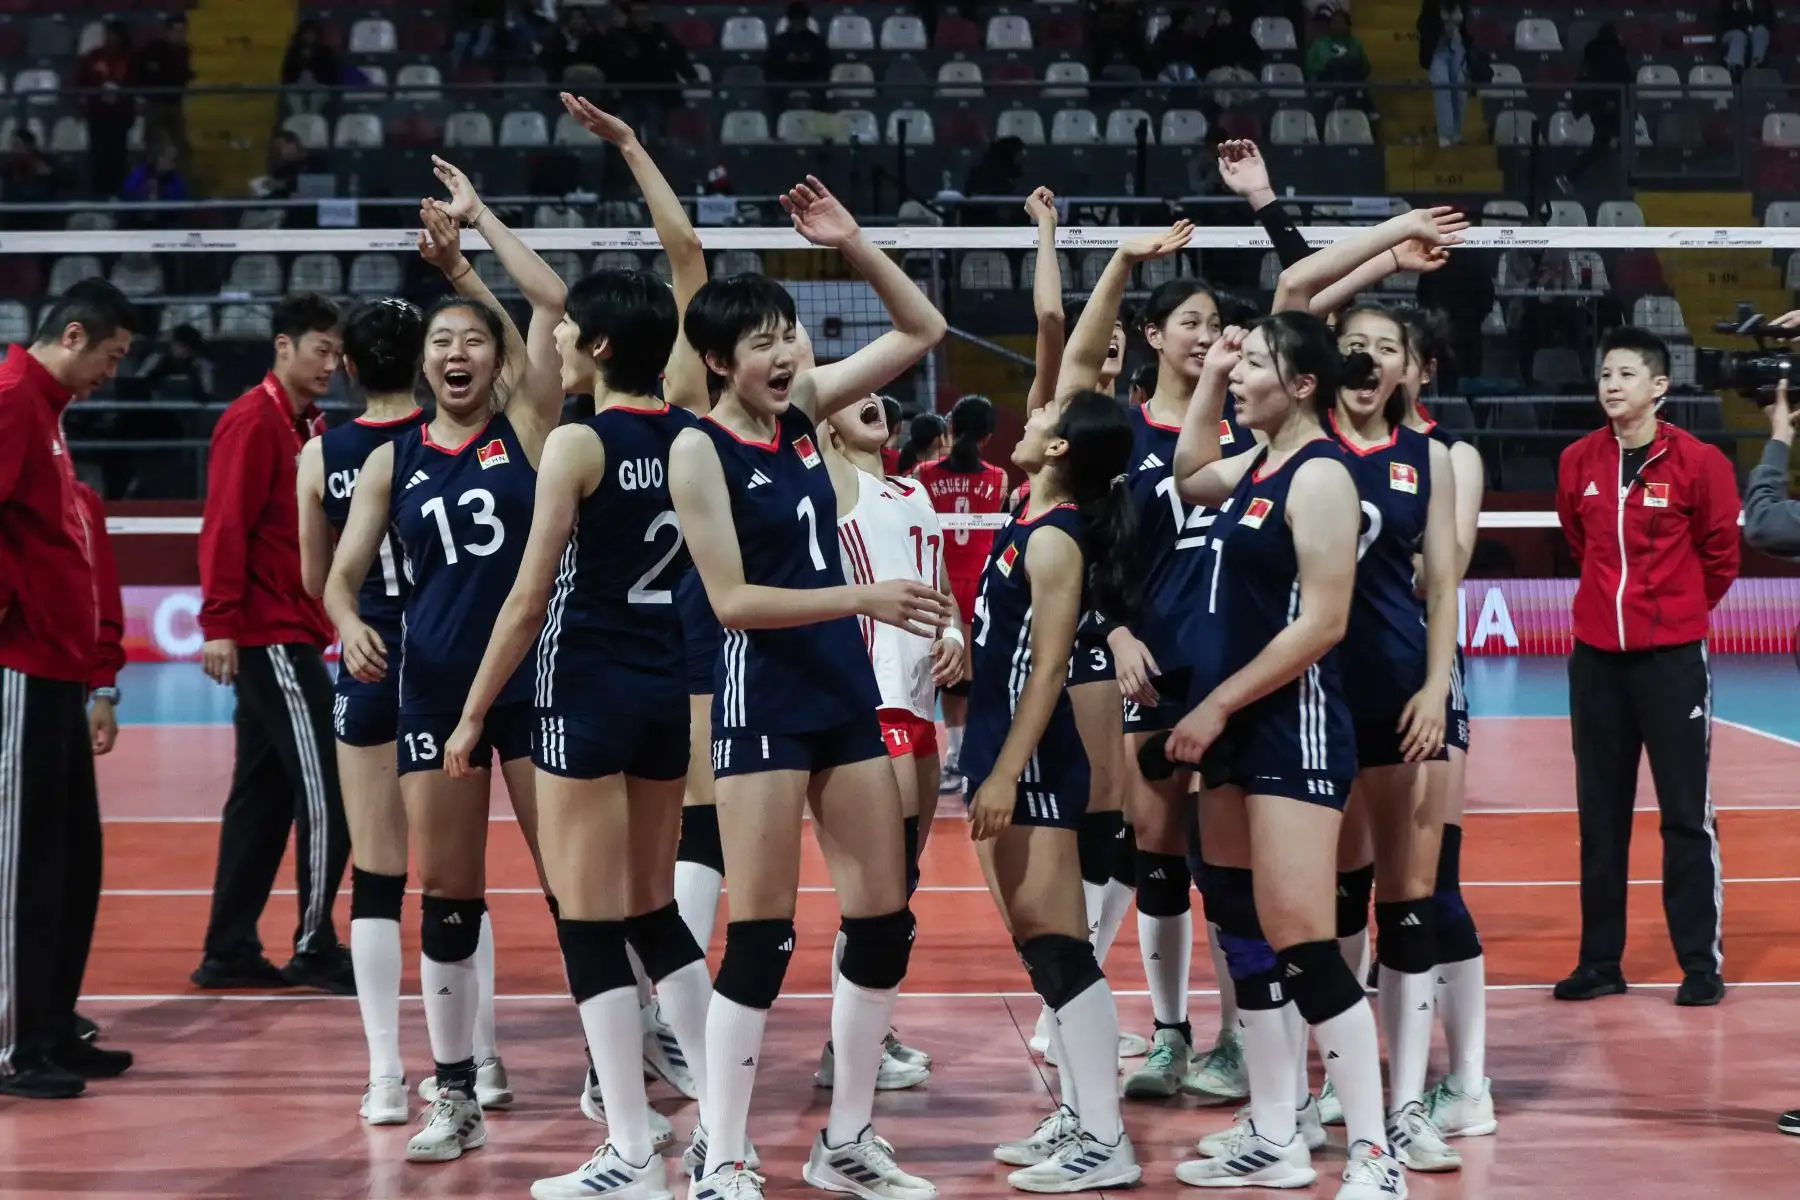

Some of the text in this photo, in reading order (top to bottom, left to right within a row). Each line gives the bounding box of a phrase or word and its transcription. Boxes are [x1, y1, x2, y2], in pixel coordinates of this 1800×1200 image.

[618, 457, 663, 491] GUO
[931, 477, 970, 498] HSUEH
[420, 488, 505, 566] 13
[796, 495, 827, 571] 1
[627, 510, 683, 604] 2
[1089, 646, 1108, 672] 3
[404, 732, 438, 762] 13
